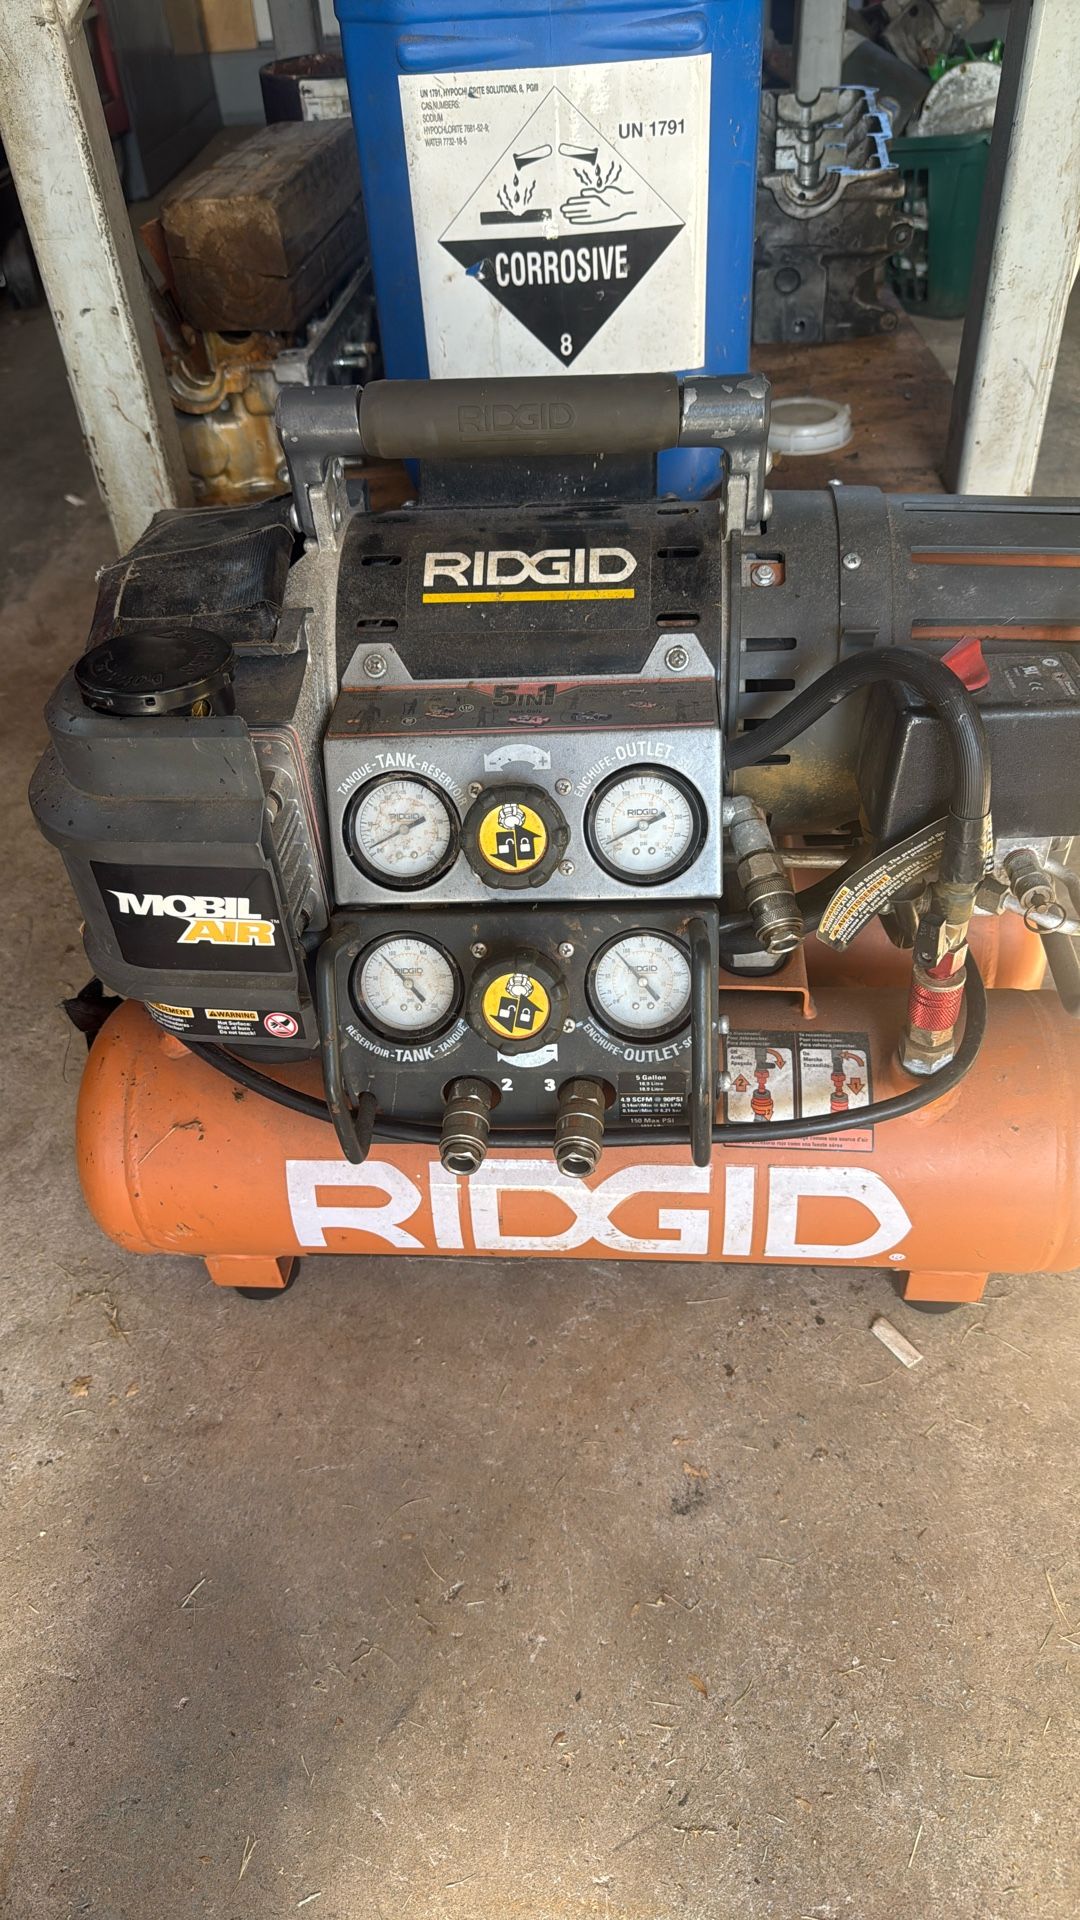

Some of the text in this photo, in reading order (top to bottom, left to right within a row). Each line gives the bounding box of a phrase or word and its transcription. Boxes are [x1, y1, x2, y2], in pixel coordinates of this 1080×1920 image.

[420, 89, 428, 98] UN
[422, 113, 443, 123] SODIUM
[618, 120, 686, 139] UN 1791
[425, 137, 442, 147] WATER
[495, 245, 628, 287] CORROSIVE
[560, 333, 573, 356] 8
[457, 401, 577, 433] RIDGID
[423, 547, 638, 587] RIDGID
[627, 808, 658, 816] RIDGID
[104, 889, 262, 920] MOBIL
[838, 874, 889, 928] AVERTISSEMENT
[176, 918, 276, 947] AIR
[217, 1011, 256, 1019] WARNING
[501, 1078, 514, 1092] 2
[544, 1078, 556, 1092] 3
[738, 1078, 744, 1087] 2
[286, 1159, 913, 1259] RIDGID
